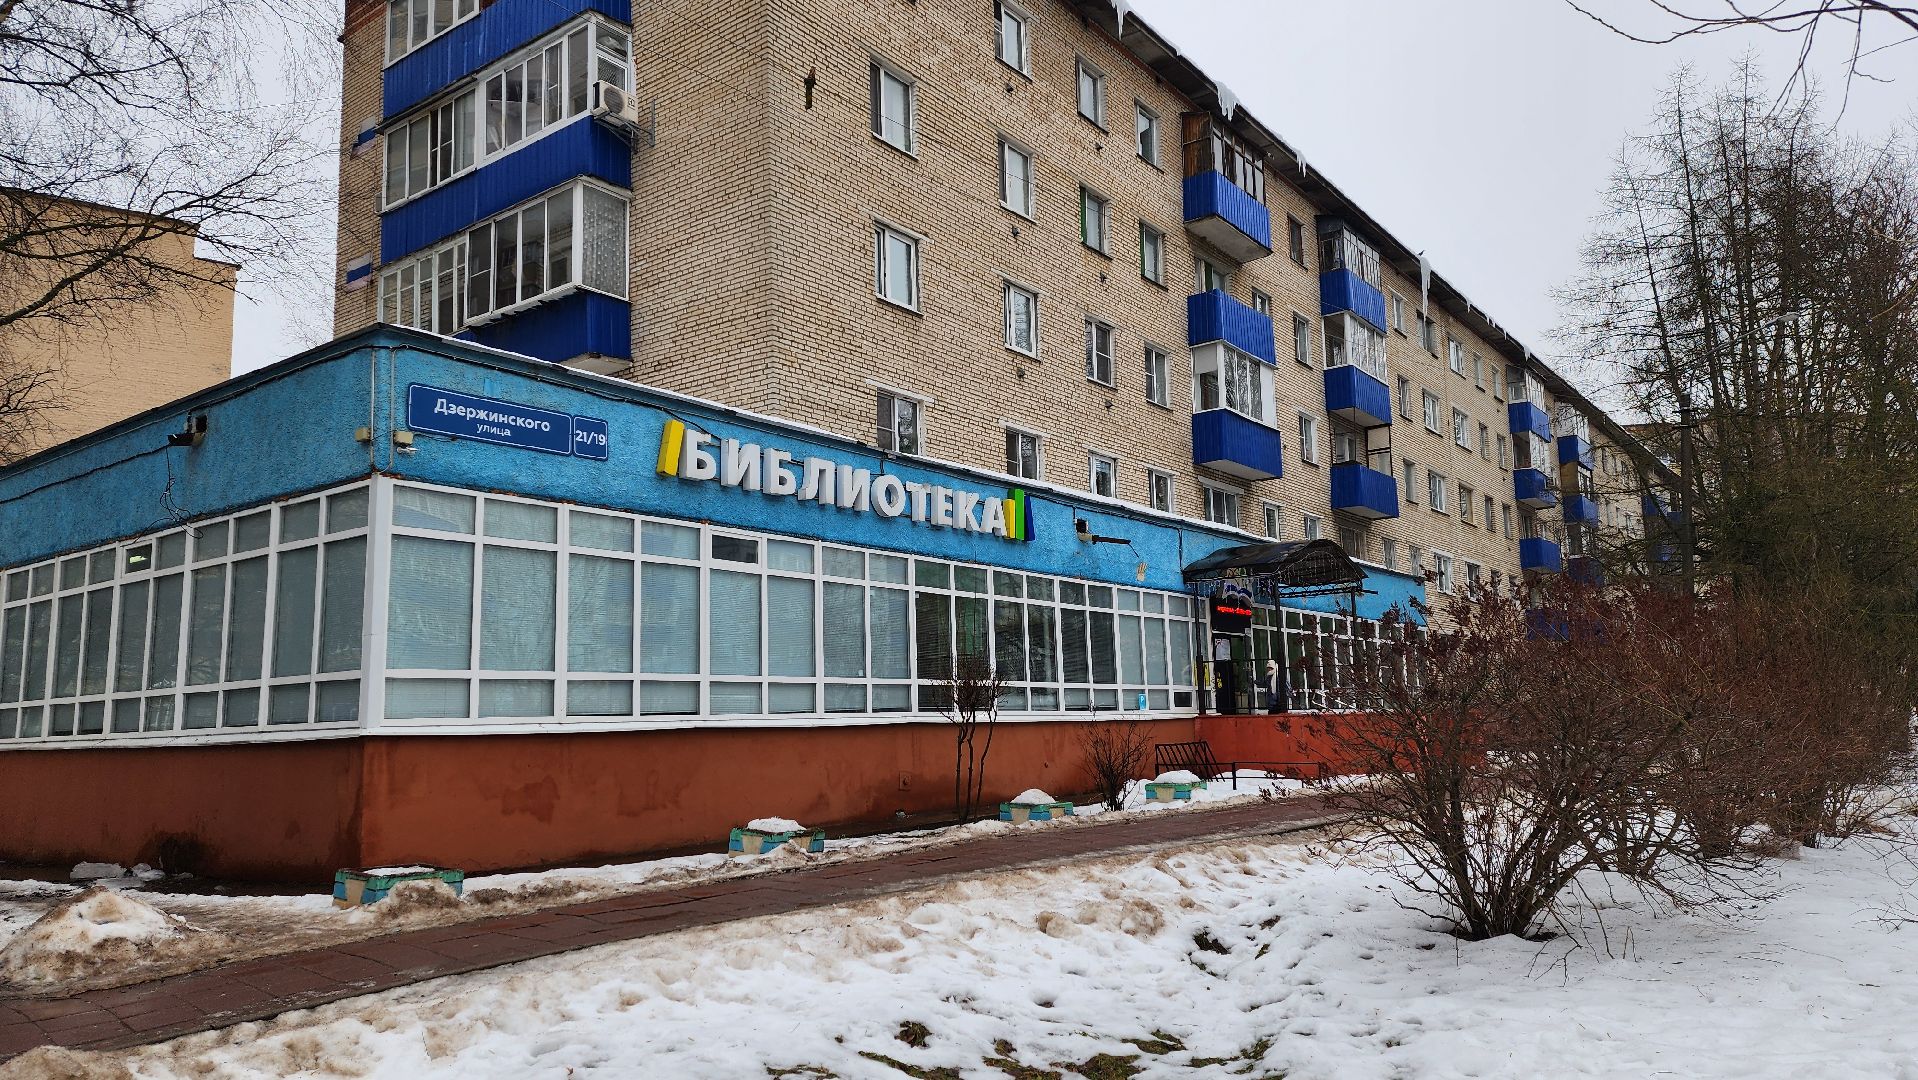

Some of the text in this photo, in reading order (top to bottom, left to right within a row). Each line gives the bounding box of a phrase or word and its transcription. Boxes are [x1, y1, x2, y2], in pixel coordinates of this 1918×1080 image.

[434, 398, 551, 432] Дзержинского
[476, 422, 511, 437] улица
[575, 429, 606, 446] 21/19
[679, 428, 1008, 537] БИБЛИОТЕКА
